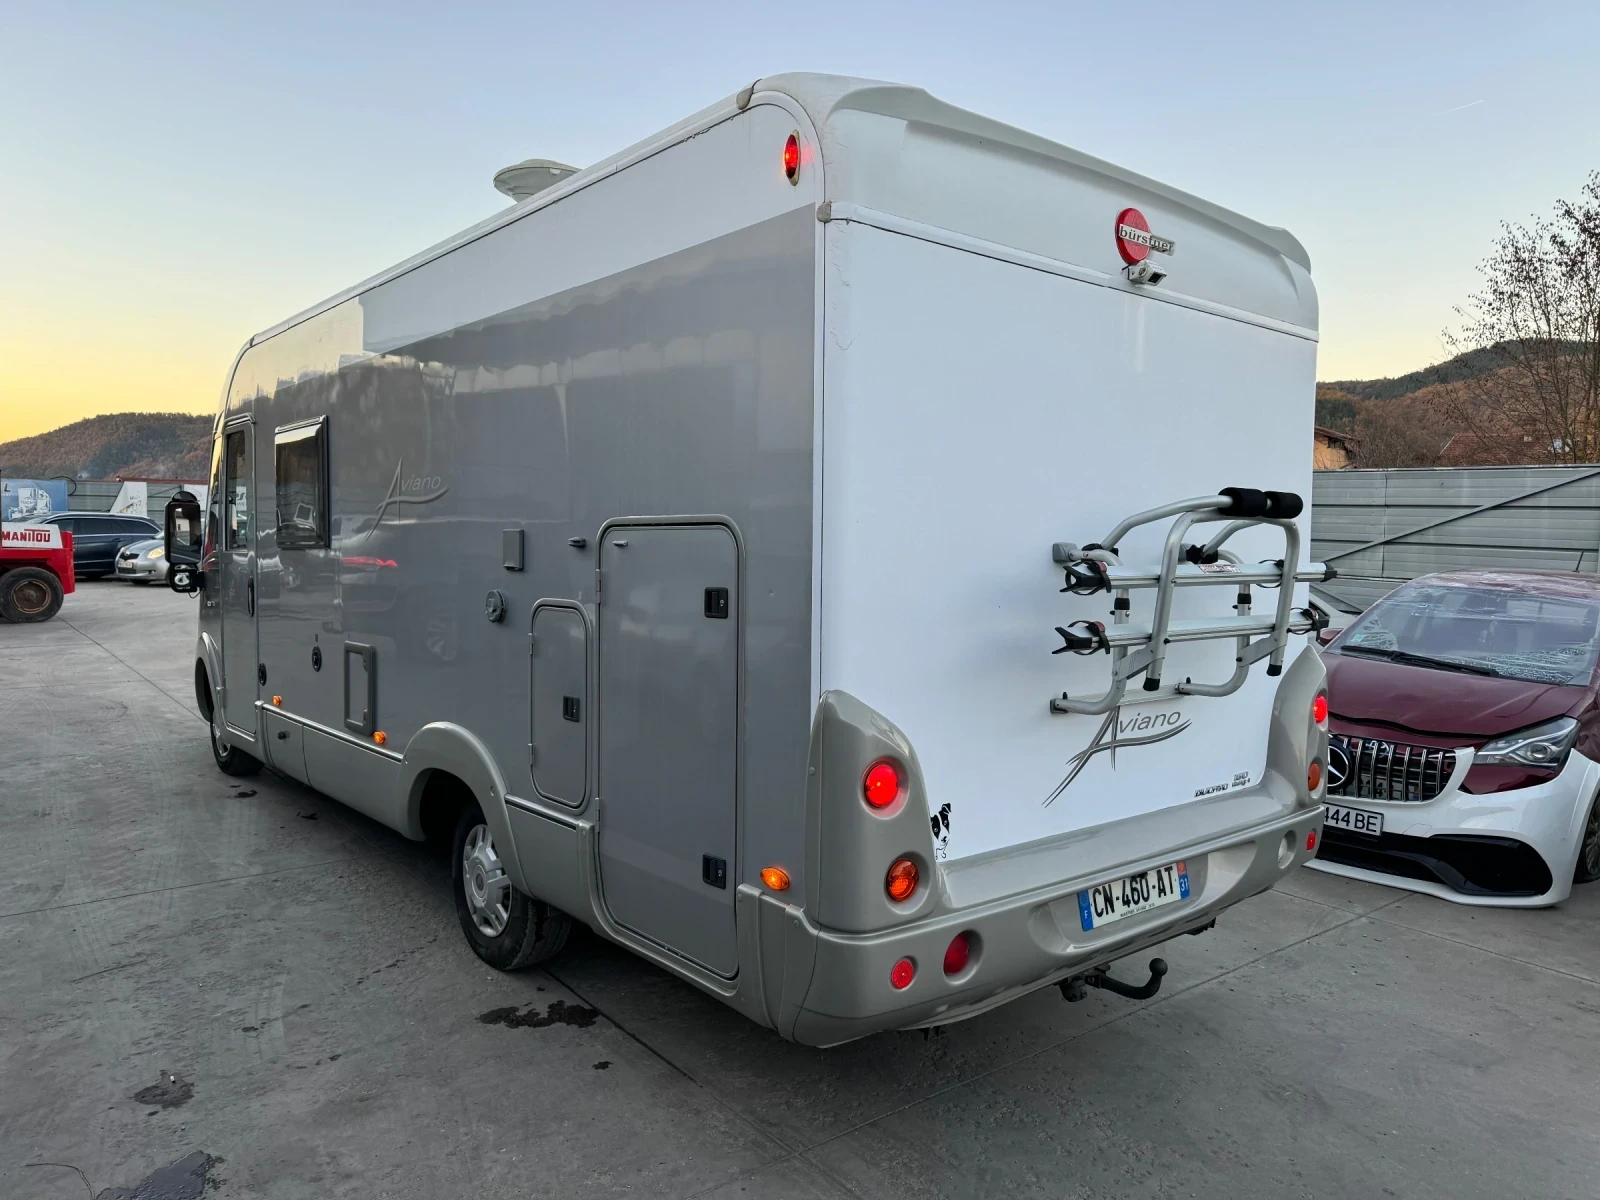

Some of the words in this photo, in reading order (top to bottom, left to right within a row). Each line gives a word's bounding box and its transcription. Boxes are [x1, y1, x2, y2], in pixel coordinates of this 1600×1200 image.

[1119, 225, 1174, 252] bürstner
[364, 457, 449, 541] Aviano
[1, 529, 51, 542] MANITOU
[1042, 705, 1192, 808] Aviano
[1354, 813, 1378, 832] BE
[1180, 878, 1189, 892] 31
